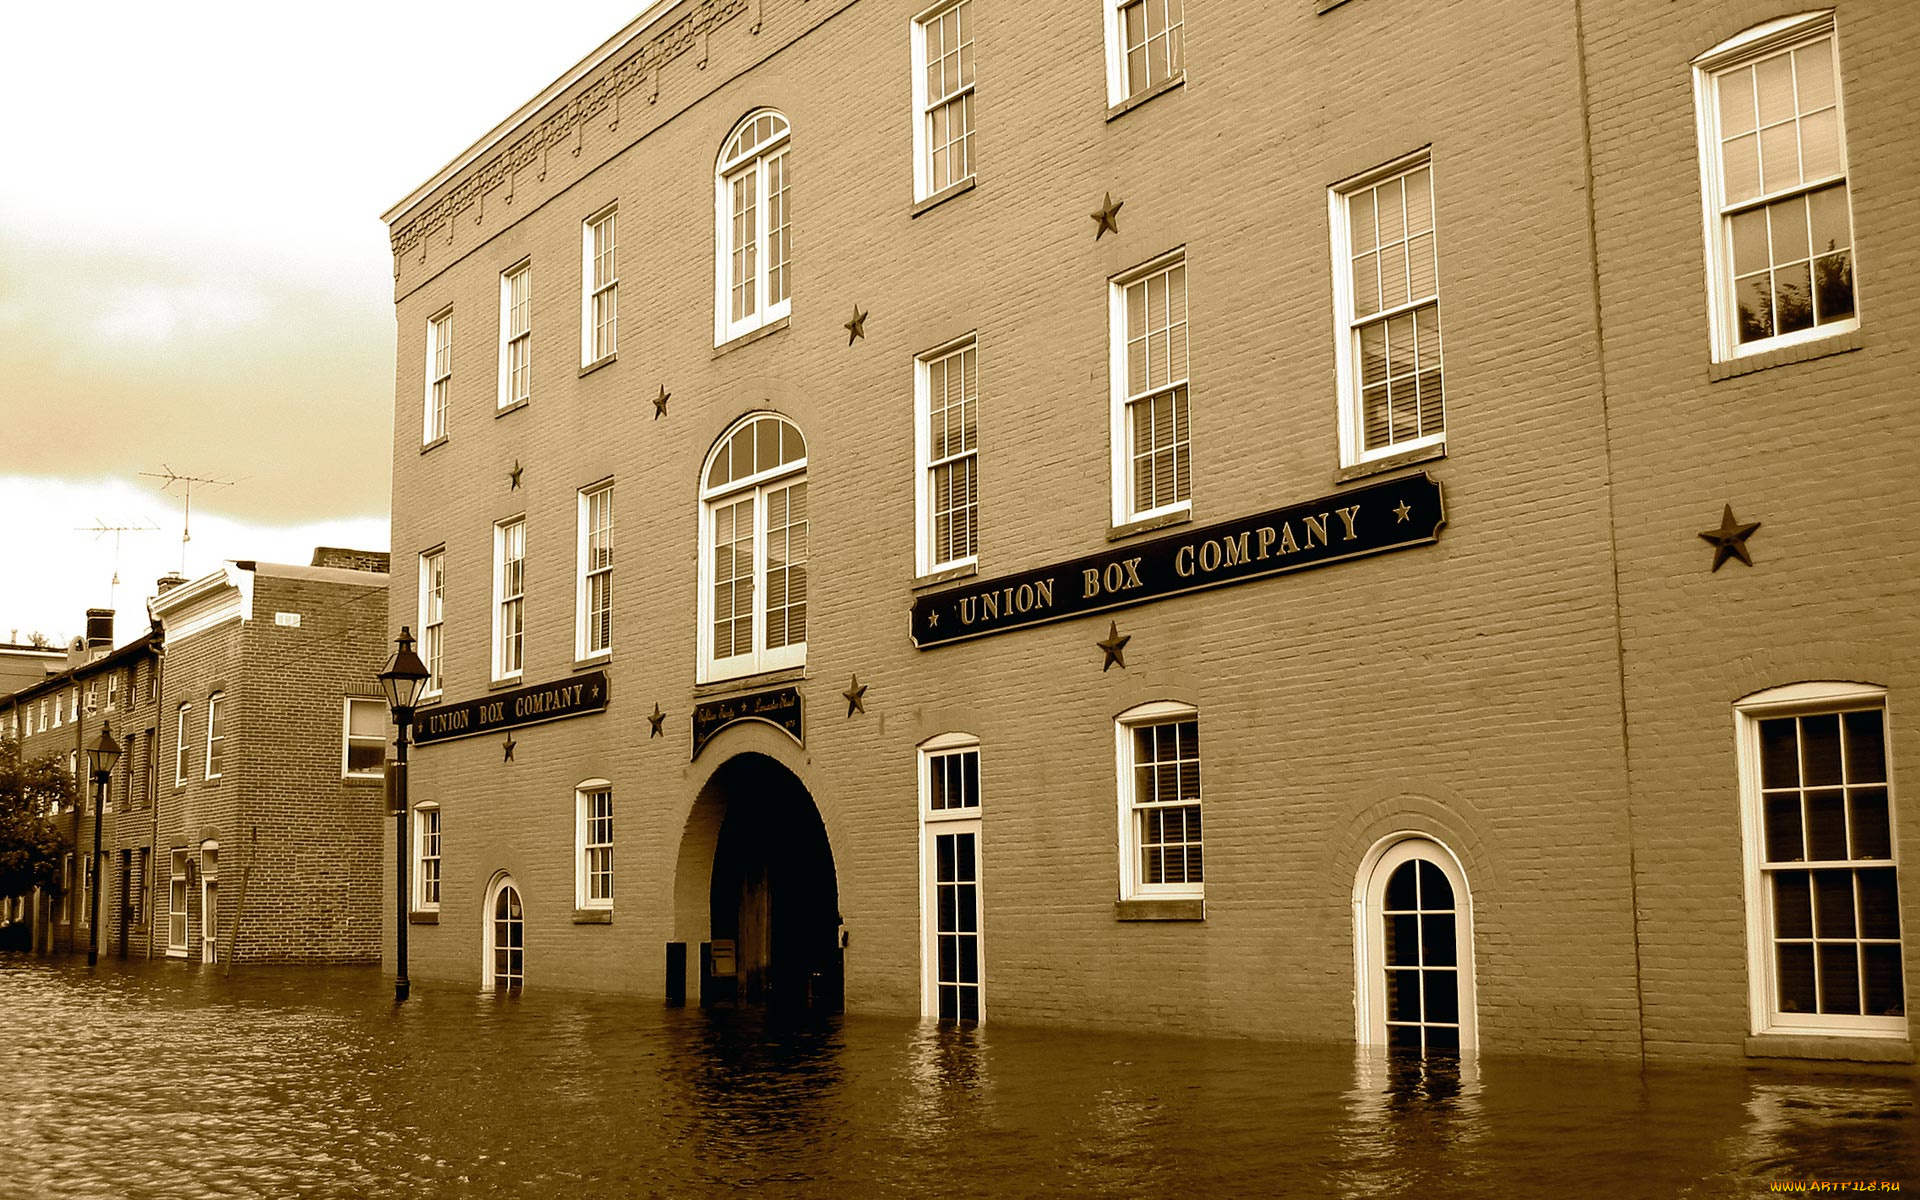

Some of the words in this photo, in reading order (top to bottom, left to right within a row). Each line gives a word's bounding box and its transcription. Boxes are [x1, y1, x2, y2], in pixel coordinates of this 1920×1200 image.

[959, 578, 1055, 626] UNION
[1082, 557, 1144, 599] BOX
[1175, 504, 1361, 578] COMPANY
[430, 709, 470, 734] UNION
[479, 701, 505, 725] BOX
[515, 684, 583, 718] COMPANY
